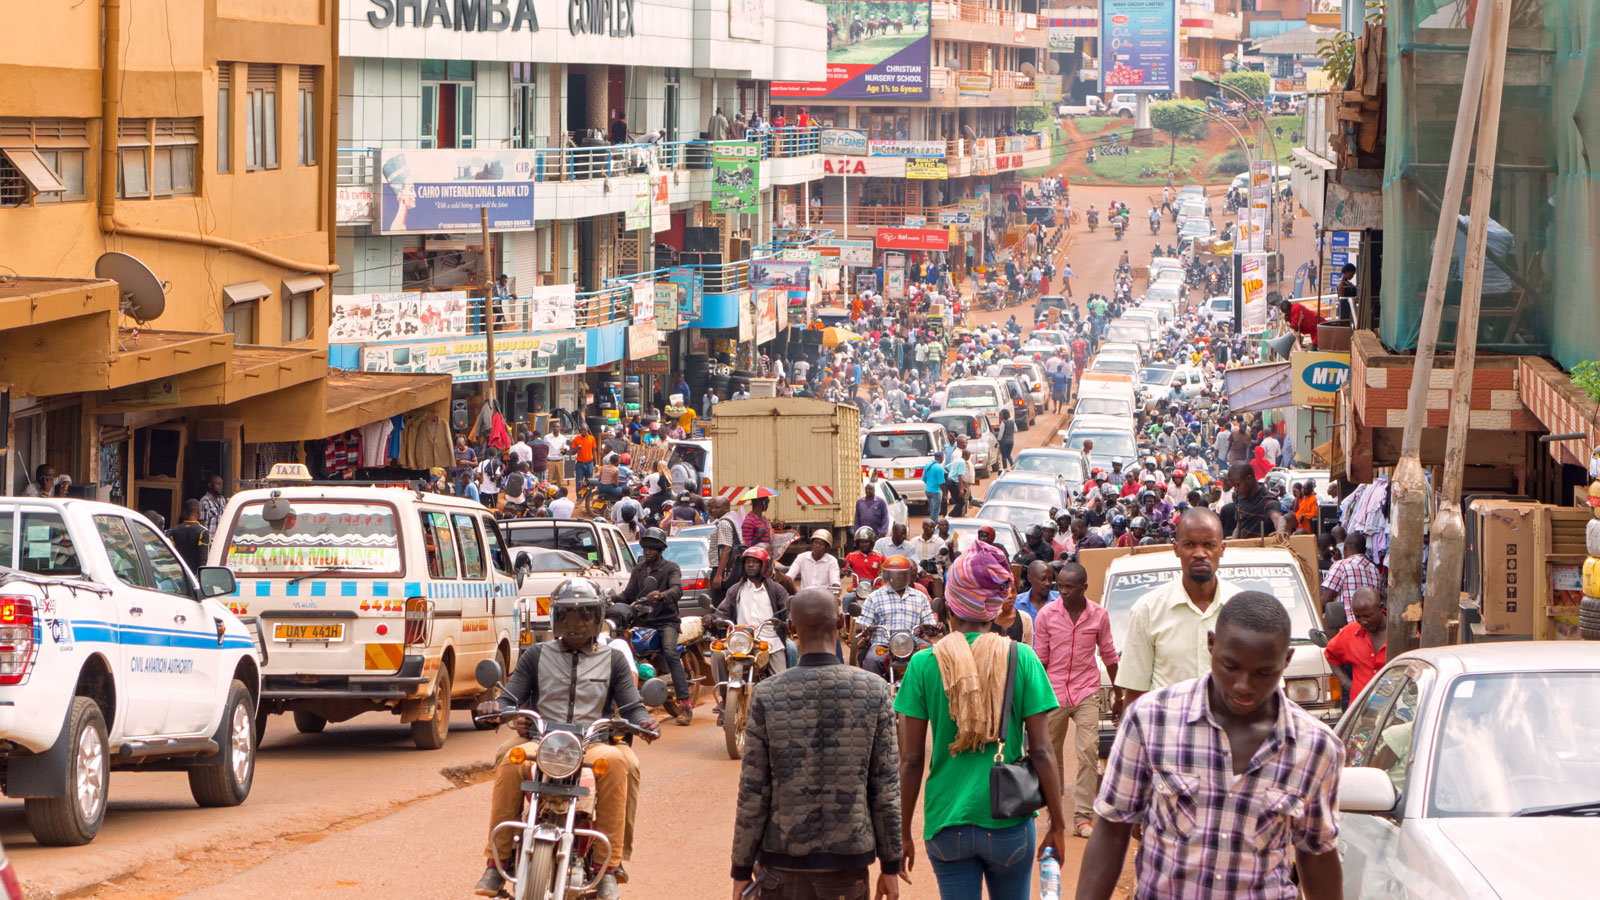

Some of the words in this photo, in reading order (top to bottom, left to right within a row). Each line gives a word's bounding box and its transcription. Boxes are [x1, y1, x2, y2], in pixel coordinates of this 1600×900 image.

[367, 0, 540, 32] SHAMBA
[568, 0, 635, 37] COMPLEX
[886, 65, 921, 73] CHRISTIAN
[864, 74, 896, 82] NURSERY
[896, 74, 923, 83] SCHOOL
[866, 84, 880, 93] Age
[891, 84, 899, 93] to
[900, 84, 923, 94] 6years
[822, 137, 838, 147] DRY
[838, 138, 866, 148] CLEANER
[417, 186, 440, 199] CAIRO
[441, 185, 496, 198] INTERNATIONAL
[497, 184, 516, 197] BANK
[516, 184, 530, 197] LTD
[493, 340, 540, 352] SOUNDS
[1311, 367, 1349, 385] MTN
[1306, 395, 1330, 404] Mobile
[275, 464, 301, 475] TAXI
[286, 625, 307, 638] UAY
[312, 624, 339, 638] 441H
[130, 656, 144, 672] CIVIL
[143, 657, 168, 673] AVIATION
[167, 658, 194, 675] AUTHORITY
